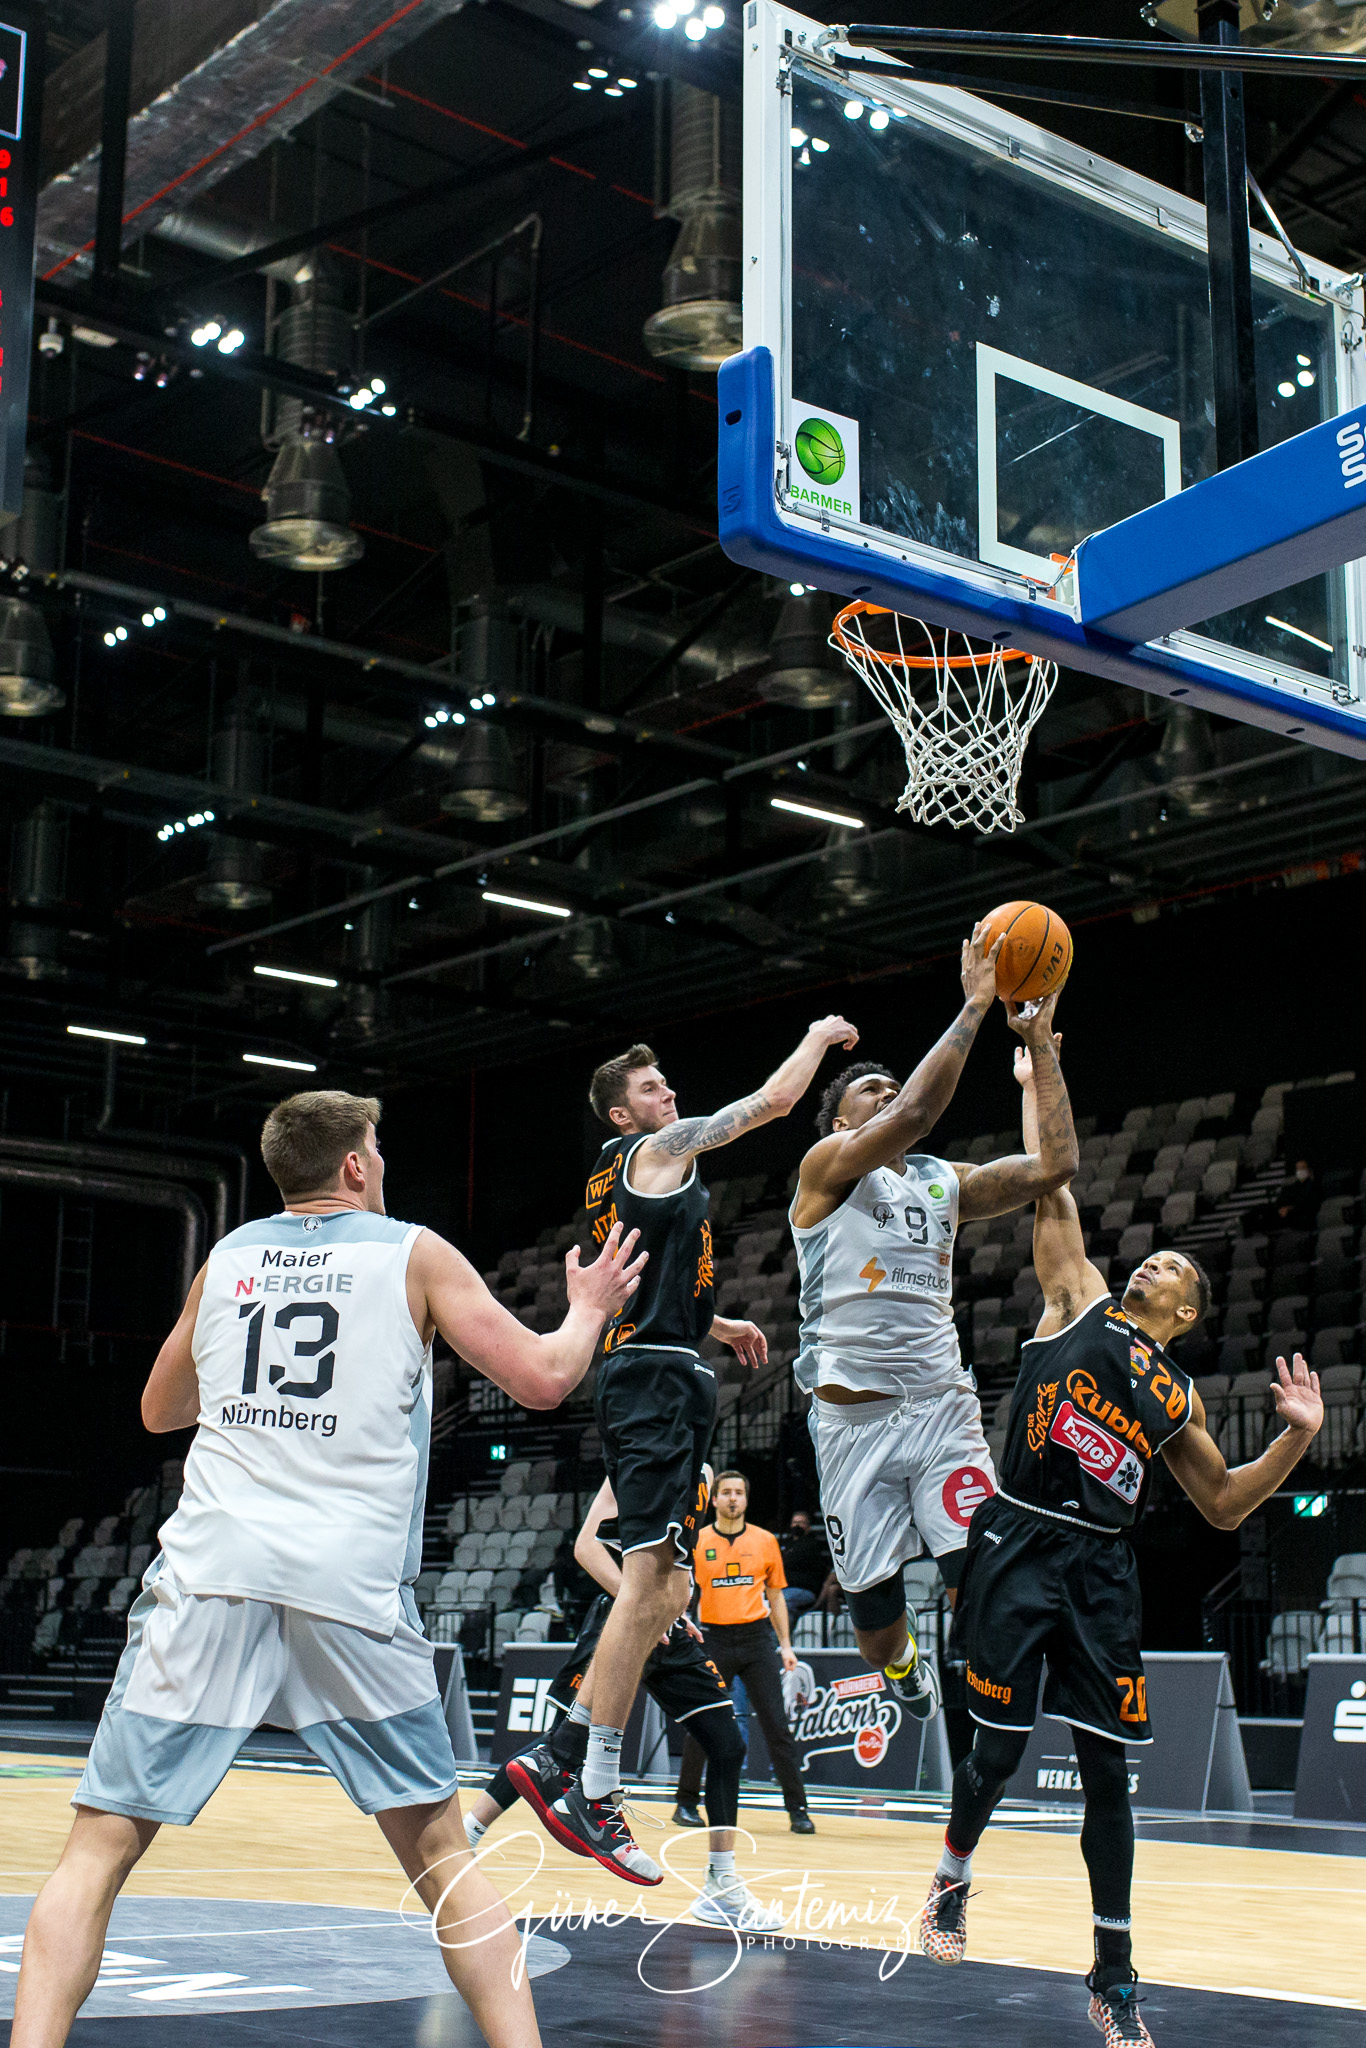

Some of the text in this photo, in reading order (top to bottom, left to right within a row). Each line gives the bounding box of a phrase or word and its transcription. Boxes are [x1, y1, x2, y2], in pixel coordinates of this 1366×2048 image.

[790, 484, 852, 516] BARMER
[904, 1205, 929, 1245] 9
[261, 1250, 333, 1267] Maier
[891, 1266, 950, 1290] filmstud
[239, 1301, 339, 1399] 13
[1150, 1362, 1187, 1420] 20
[221, 1403, 337, 1437] Nürnberg
[826, 1514, 845, 1556] 9
[786, 1688, 900, 1742] Falcons
[1116, 1676, 1147, 1722] 20
